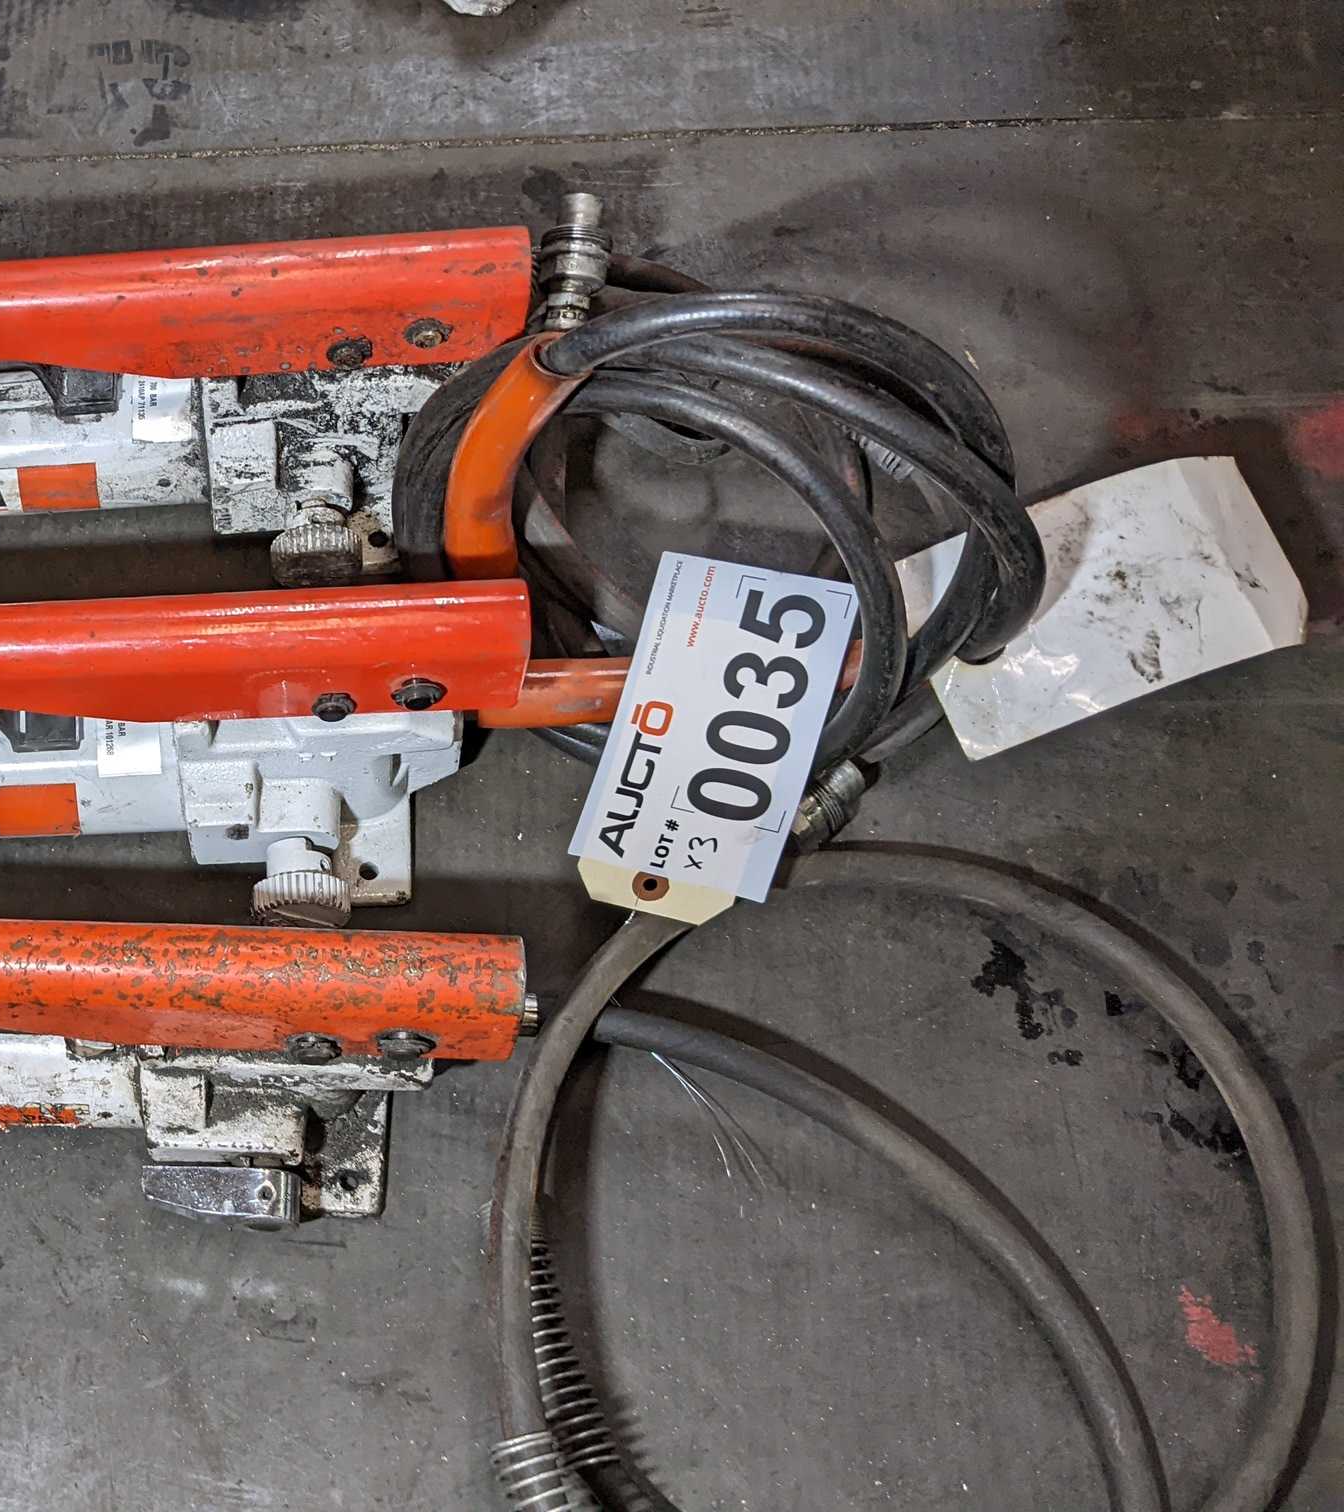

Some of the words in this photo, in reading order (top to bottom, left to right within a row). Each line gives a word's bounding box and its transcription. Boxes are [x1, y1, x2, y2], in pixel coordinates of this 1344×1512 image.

[655, 601, 672, 642] LIQUIDATION
[686, 565, 717, 648] www.aucto.com
[686, 588, 826, 822] 0035
[649, 833, 674, 869] LOT
